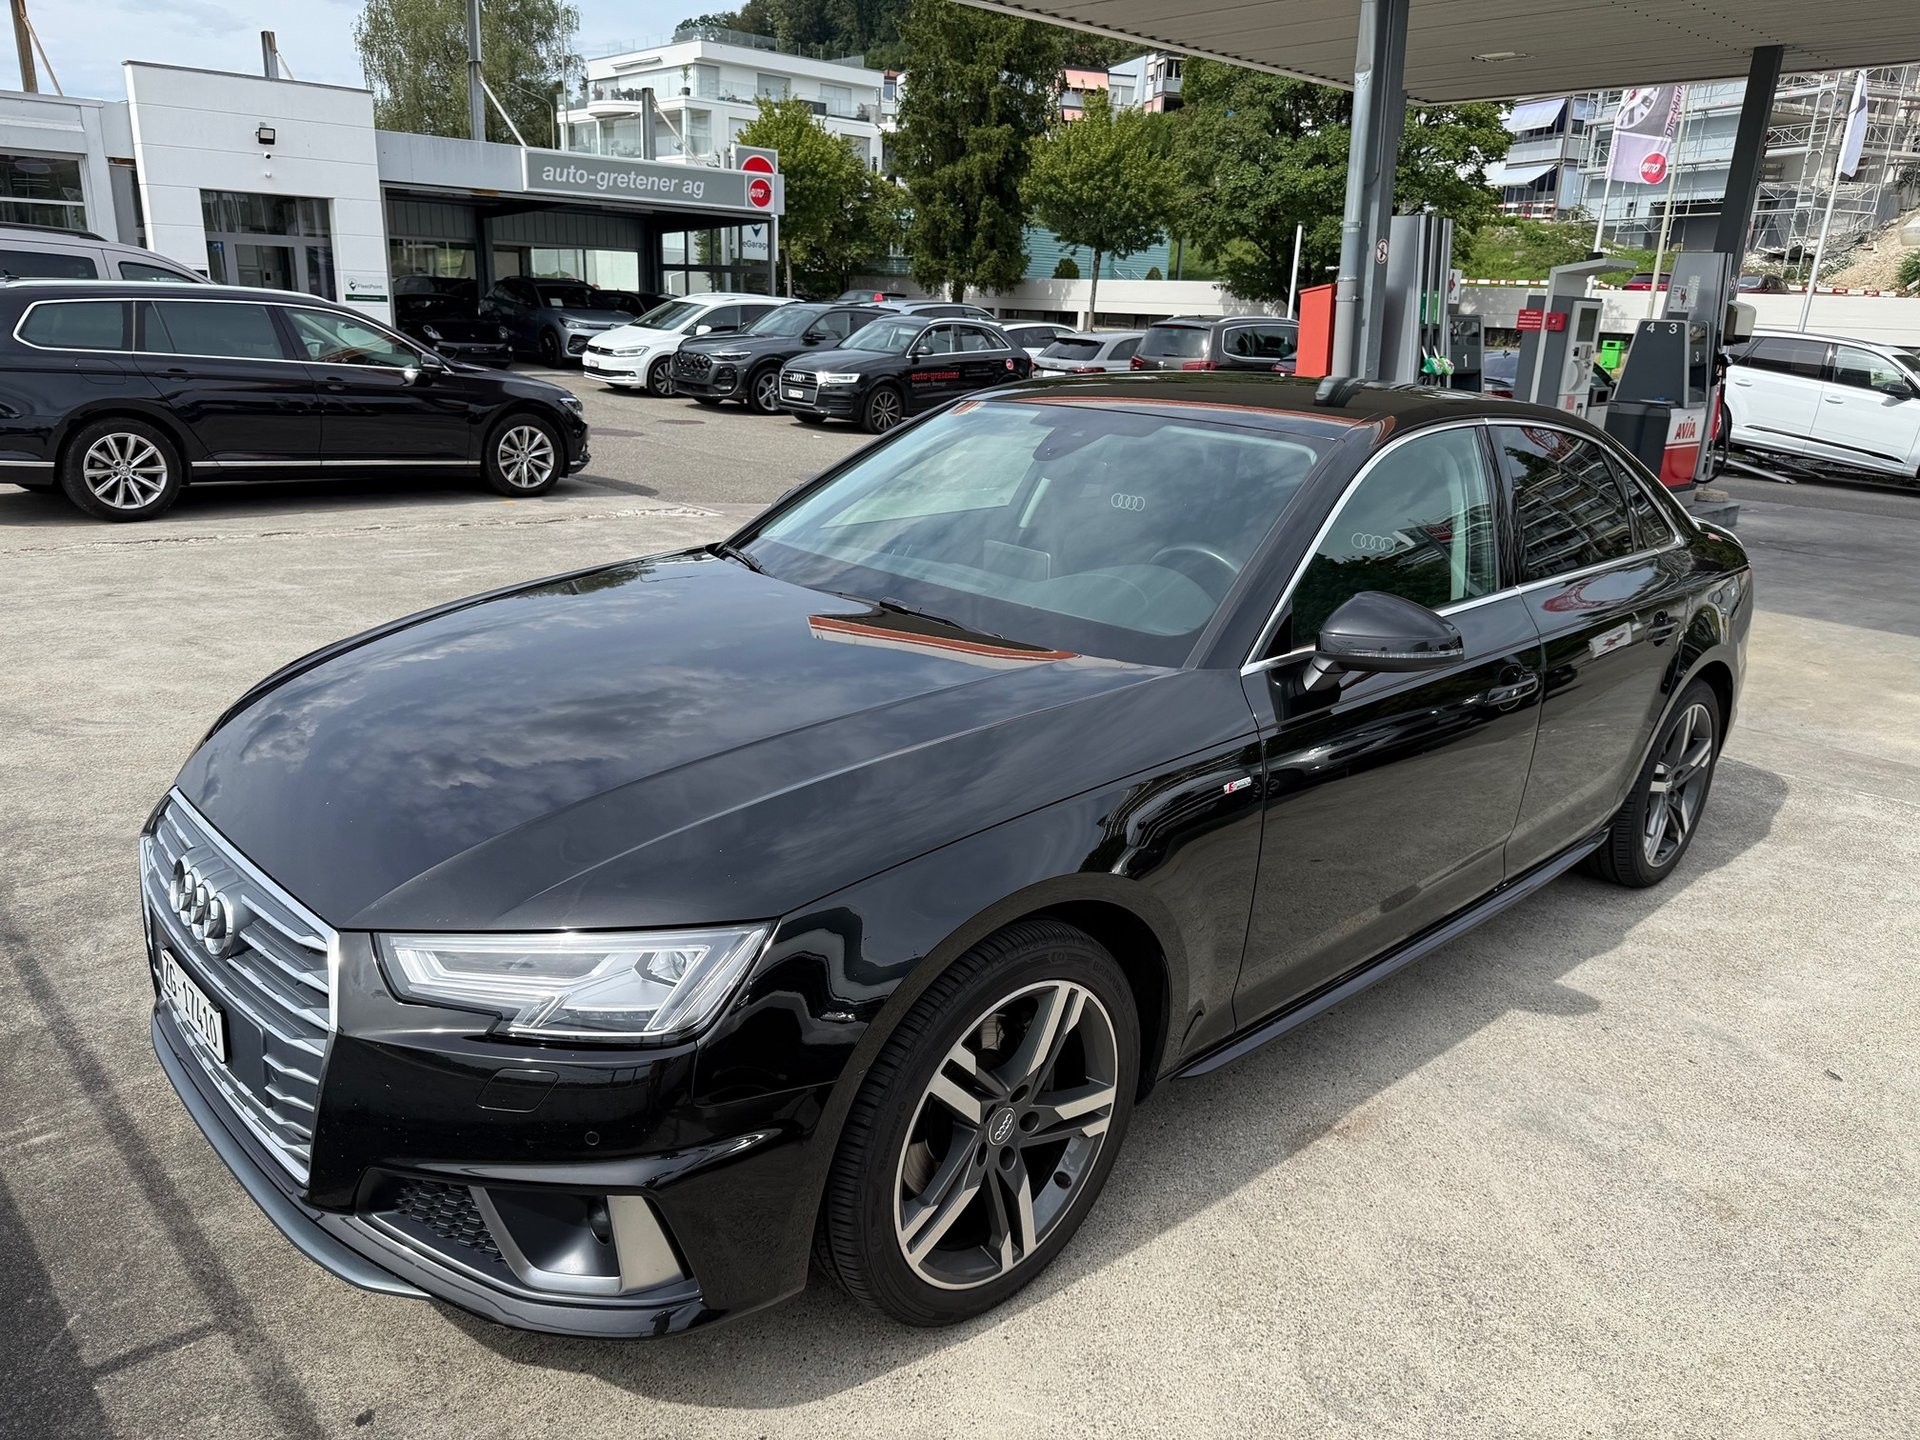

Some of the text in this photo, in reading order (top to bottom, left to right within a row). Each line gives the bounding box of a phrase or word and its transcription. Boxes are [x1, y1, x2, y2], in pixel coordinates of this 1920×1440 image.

[542, 165, 705, 198] auto-gretener ag
[1646, 322, 1678, 334] 4 3
[1463, 354, 1468, 367] 1
[1695, 351, 1700, 362] 3
[1674, 422, 1696, 440] AVIA
